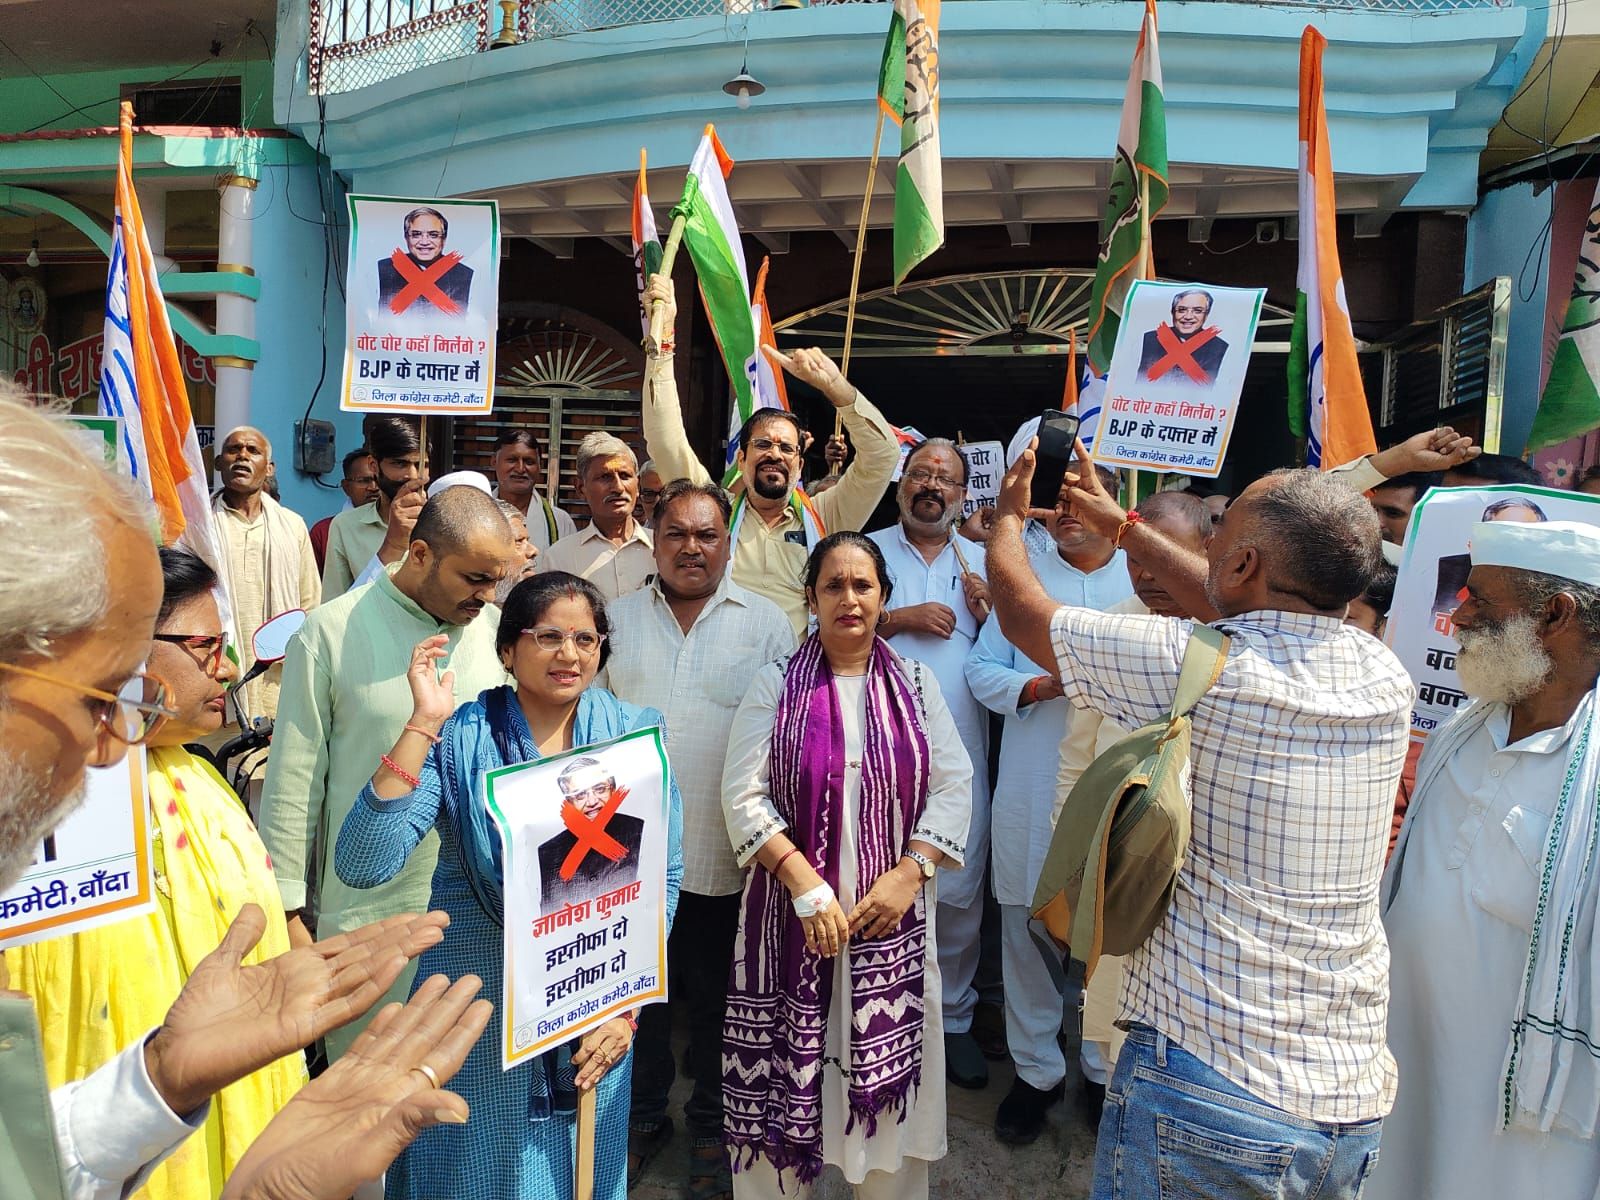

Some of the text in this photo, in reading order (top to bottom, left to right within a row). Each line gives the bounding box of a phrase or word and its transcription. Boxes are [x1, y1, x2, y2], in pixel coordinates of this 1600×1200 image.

[356, 332, 377, 351] वोट
[380, 333, 403, 352] चोर
[405, 334, 430, 353] कहाँ
[433, 334, 474, 354] मिलेंगे
[359, 359, 391, 379] BJP
[396, 357, 412, 380] के
[415, 362, 460, 382] दफ्तर
[372, 388, 397, 401] जिला
[399, 390, 431, 404] कांग्रेस
[1111, 395, 1132, 412] वोट
[1133, 397, 1152, 414] चोर
[1154, 401, 1178, 417] कहाँ
[1178, 401, 1216, 421] मिलेंगे
[1108, 418, 1138, 437] BJP
[1140, 419, 1156, 439] के
[1158, 424, 1200, 445] दफ्तर
[970, 447, 991, 466] चोर
[1115, 445, 1138, 459] जिला
[970, 471, 991, 489] चोर
[595, 880, 642, 921] कुमार
[545, 915, 629, 972] इस्तीफा दो
[544, 949, 627, 1008] इस्तीफा दो
[537, 1016, 565, 1038] जिला
[567, 998, 600, 1022] कांग्रेस
